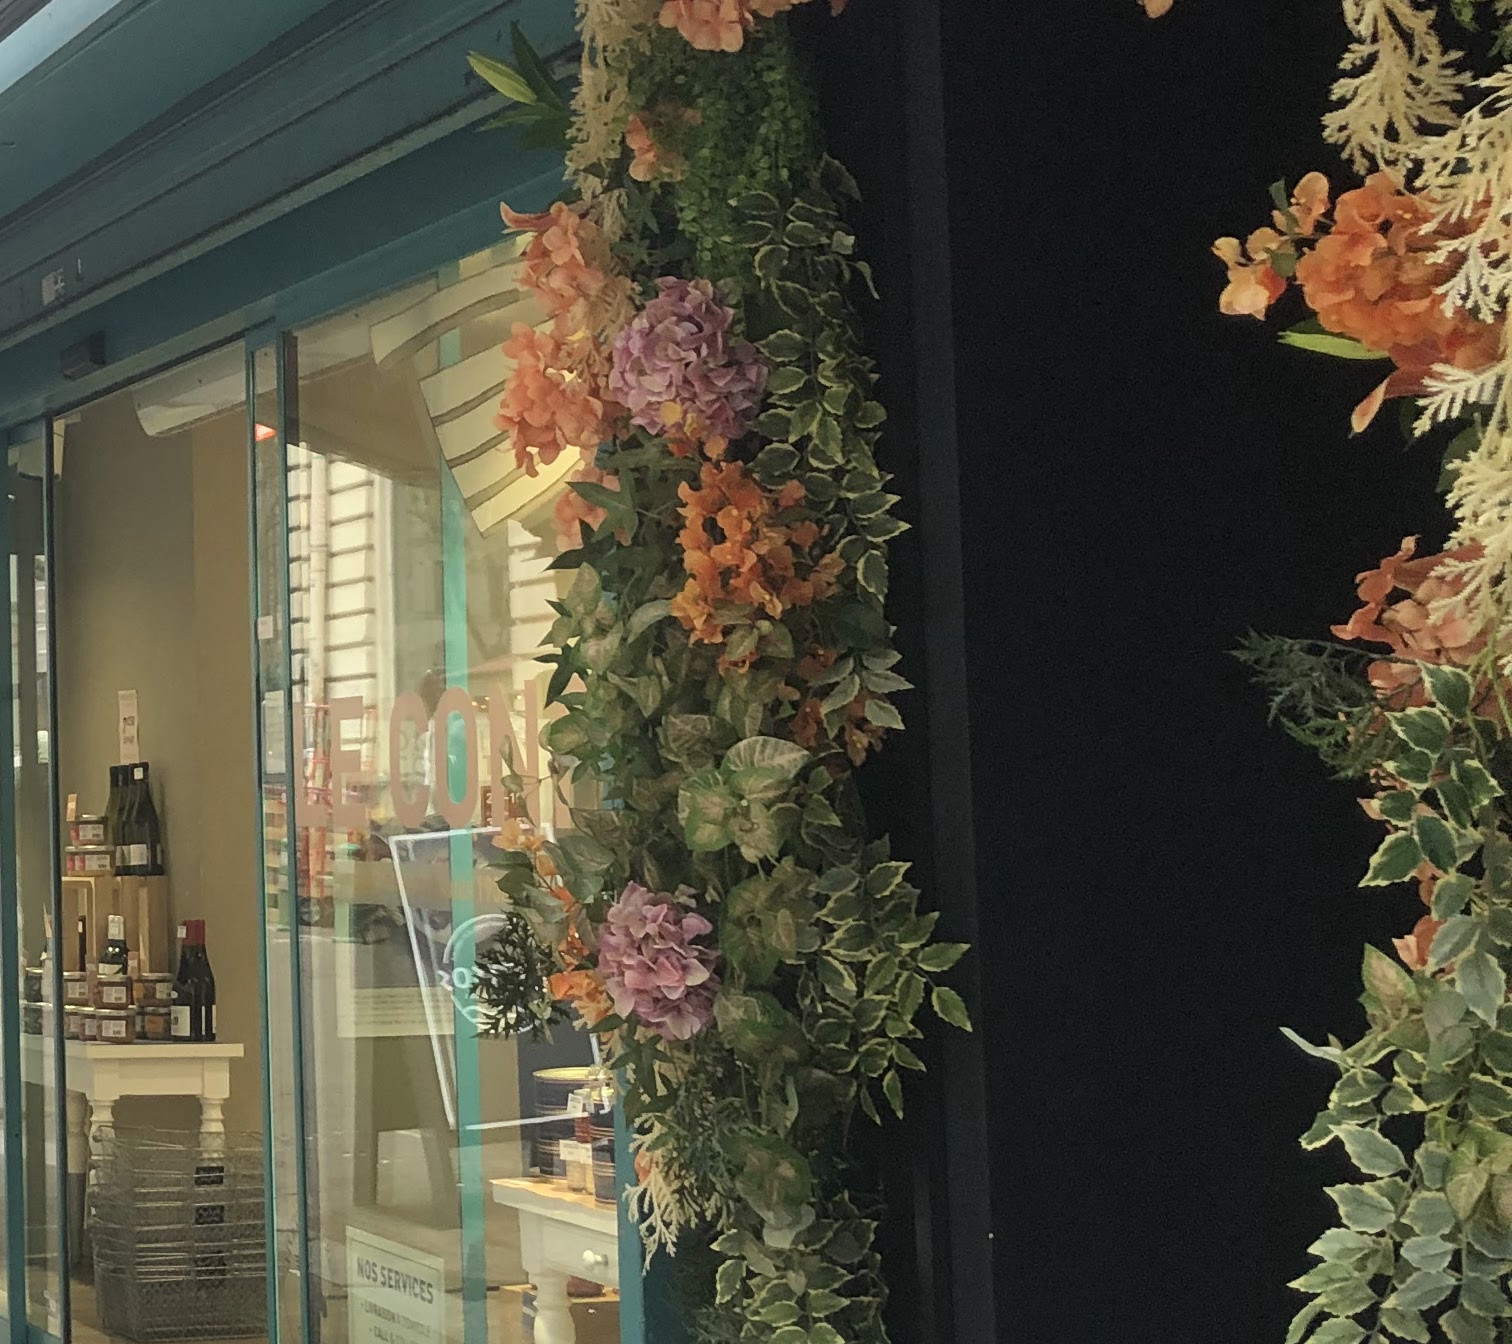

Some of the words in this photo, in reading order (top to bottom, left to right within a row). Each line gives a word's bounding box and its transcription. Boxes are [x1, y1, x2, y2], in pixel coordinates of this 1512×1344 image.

[389, 674, 580, 830] CON
[356, 1256, 378, 1282] NOS
[380, 1265, 434, 1305] SERVICES
